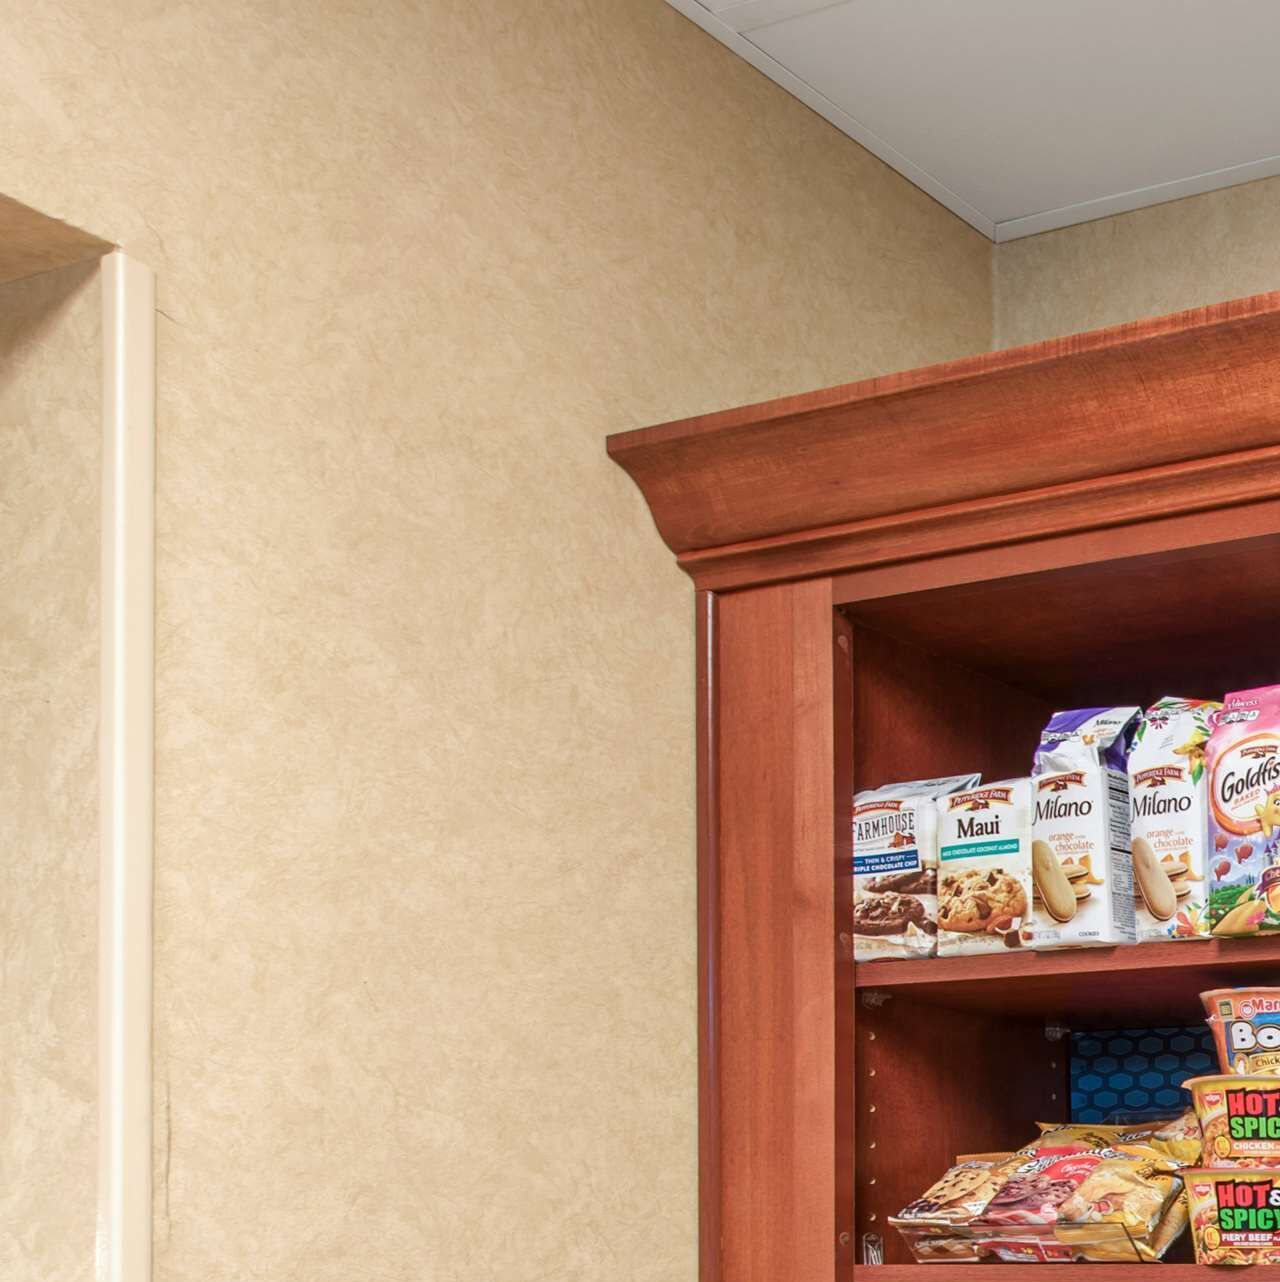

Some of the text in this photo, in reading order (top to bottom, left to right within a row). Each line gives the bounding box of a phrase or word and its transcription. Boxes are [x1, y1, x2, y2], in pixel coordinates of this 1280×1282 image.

[1032, 796, 1092, 826] Milano
[1131, 791, 1192, 823] Milano
[957, 815, 1001, 839] Maui
[1229, 1090, 1280, 1116] HOT
[1233, 1142, 1275, 1151] CHICKEN
[1218, 1183, 1271, 1208] HOT
[1221, 1233, 1273, 1243] FIERY BEEF
